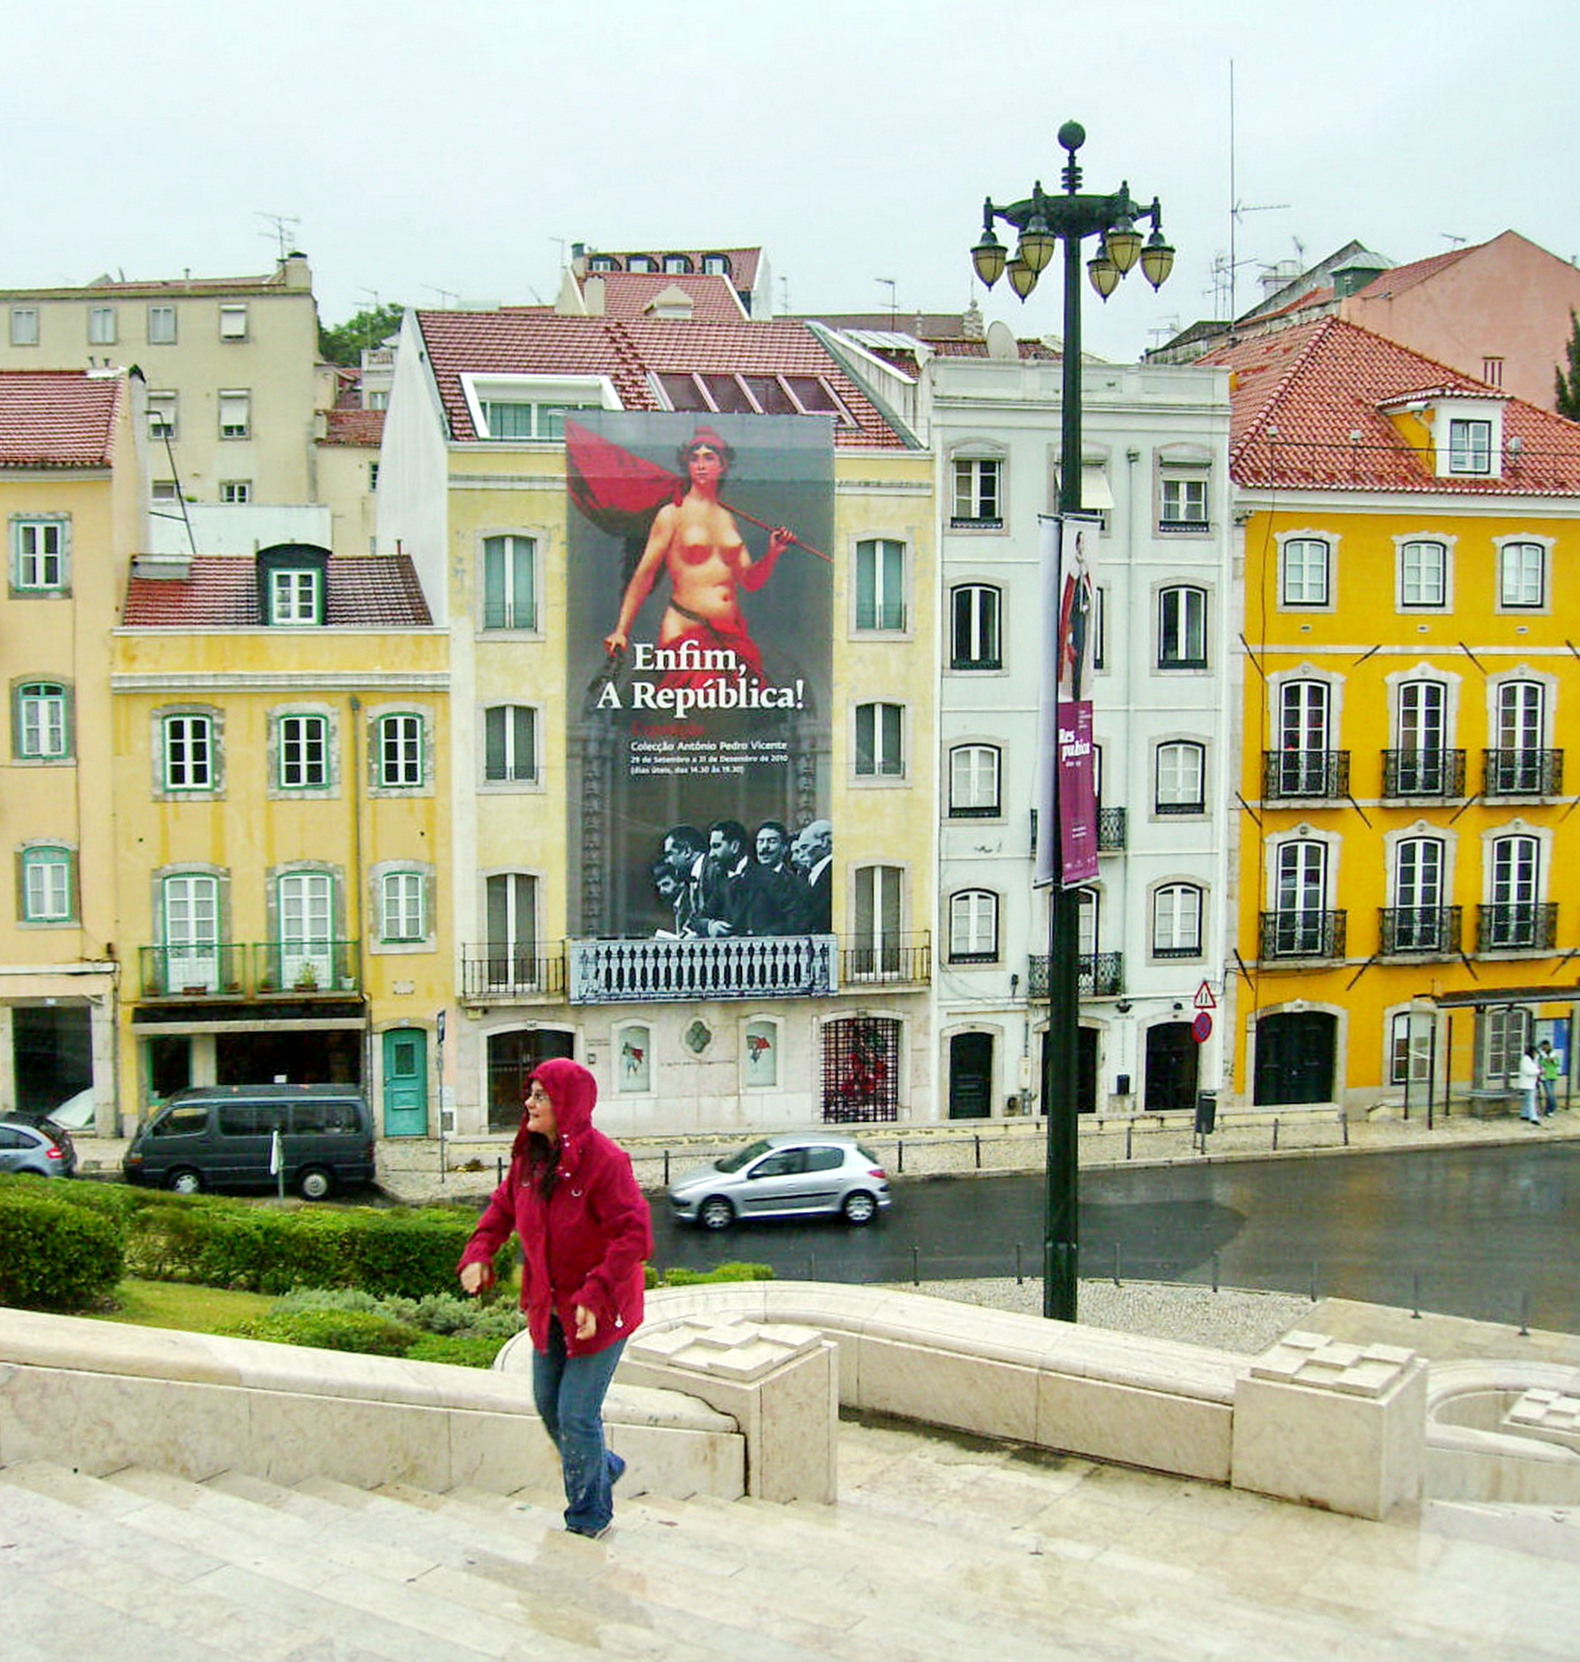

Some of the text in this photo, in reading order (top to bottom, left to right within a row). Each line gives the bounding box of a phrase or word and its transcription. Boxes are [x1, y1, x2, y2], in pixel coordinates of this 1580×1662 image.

[633, 640, 746, 676] Enfim,
[596, 677, 804, 718] A República!
[631, 740, 788, 753] Colecção António Pedro Vicente
[653, 755, 690, 763] Setembro
[720, 754, 758, 763] Dezembro
